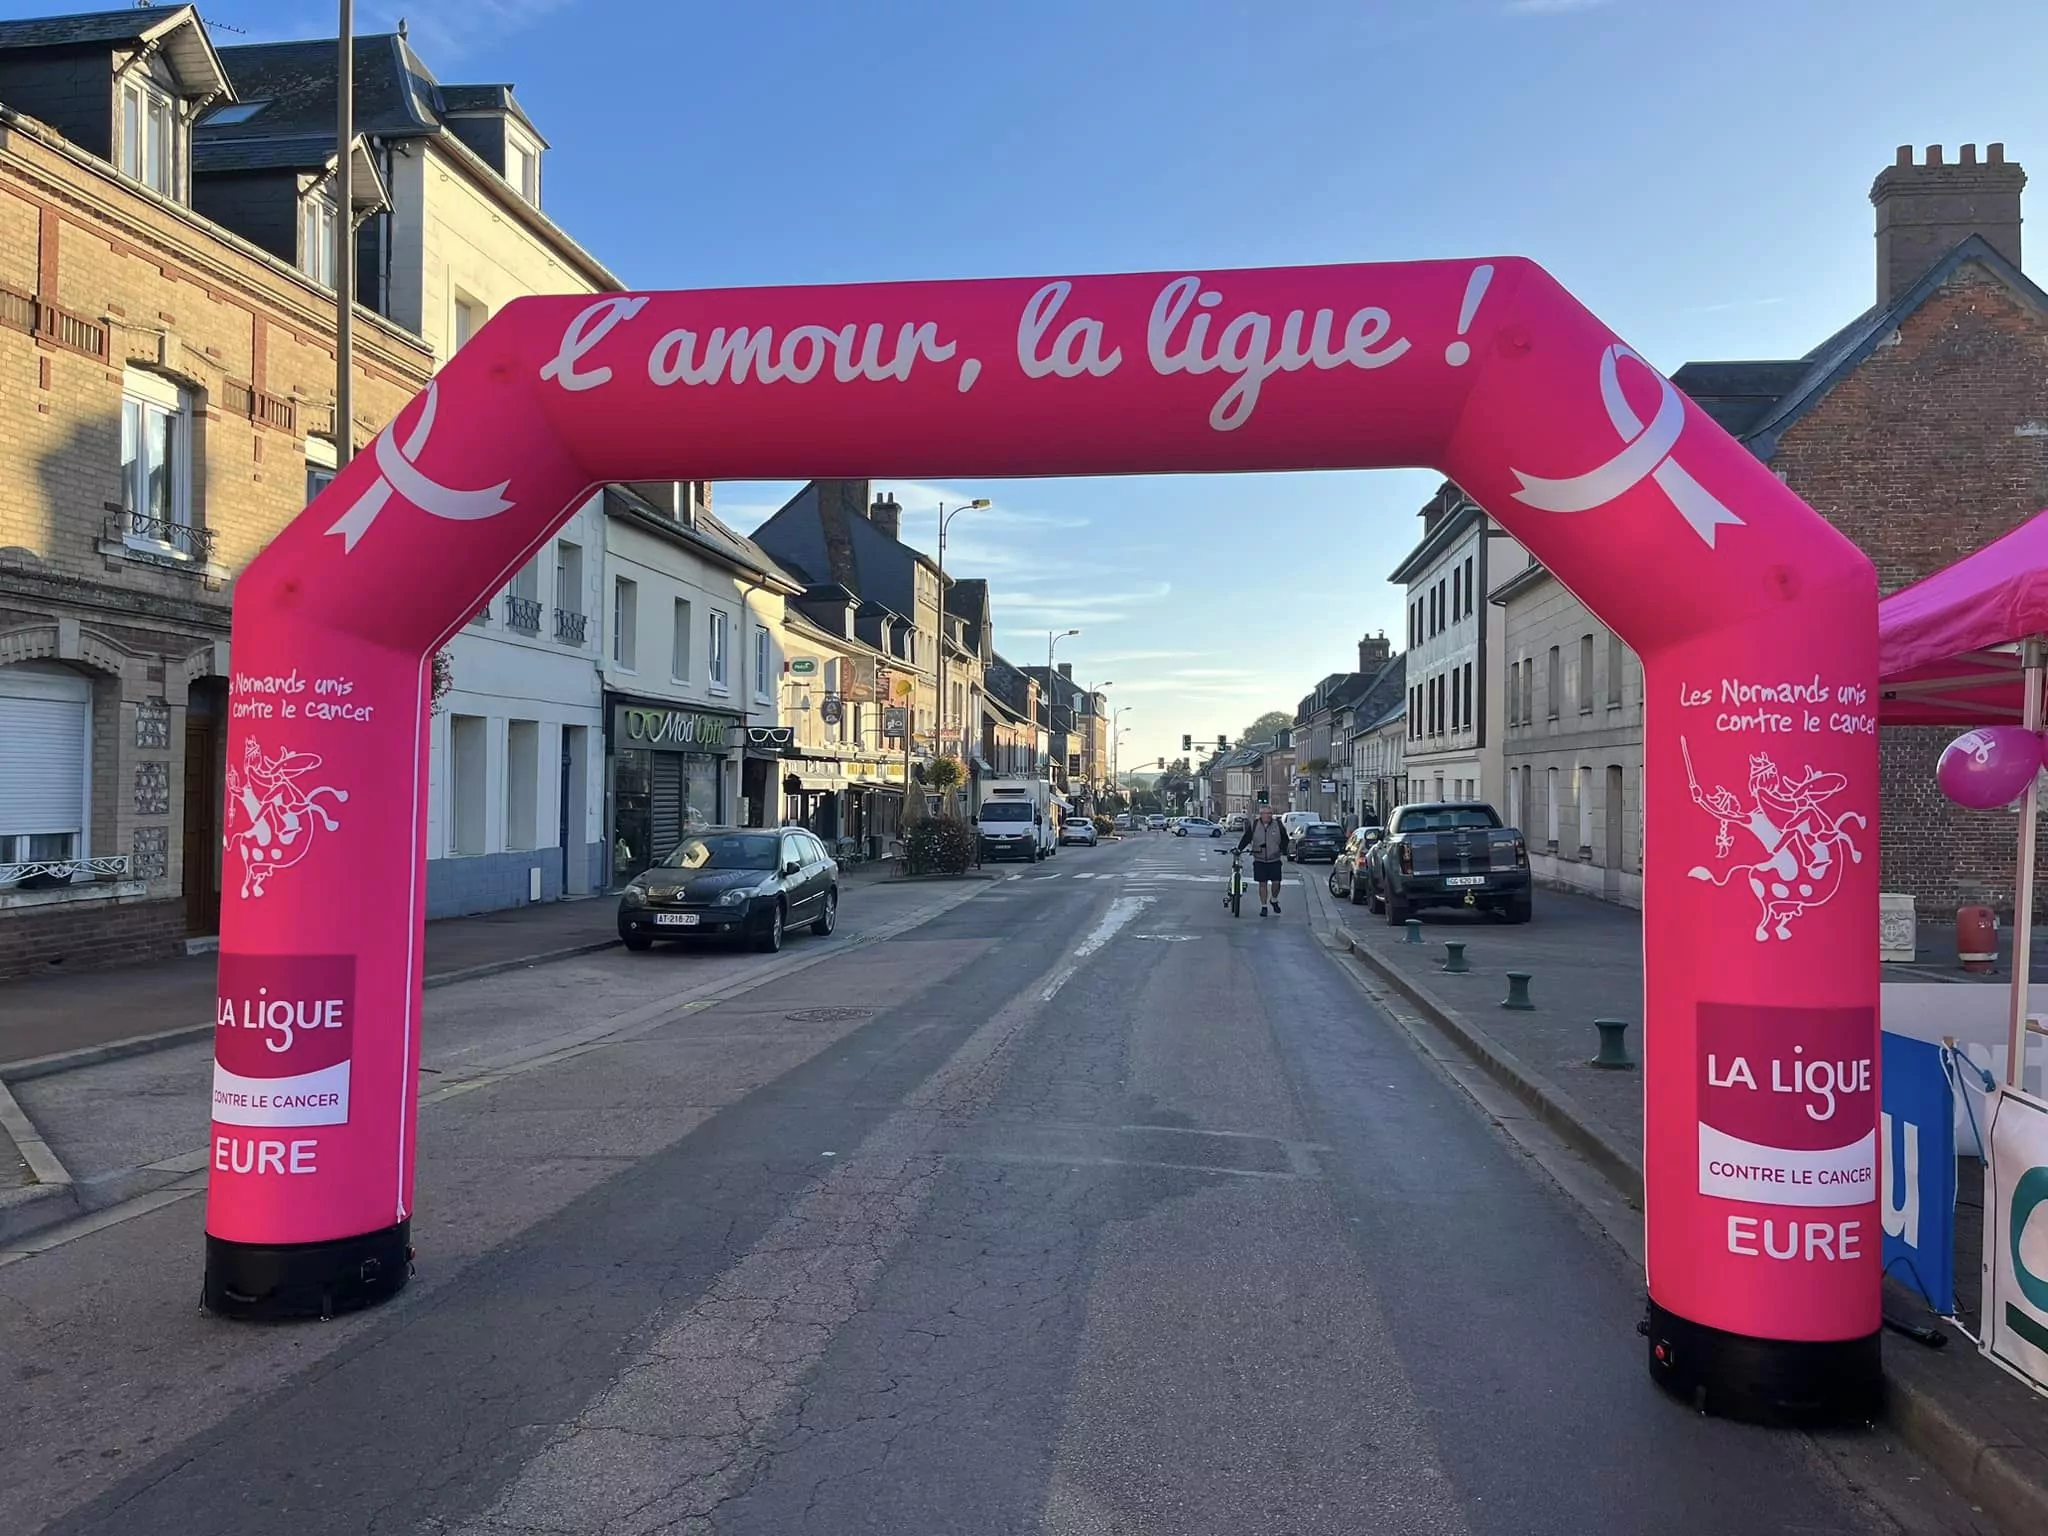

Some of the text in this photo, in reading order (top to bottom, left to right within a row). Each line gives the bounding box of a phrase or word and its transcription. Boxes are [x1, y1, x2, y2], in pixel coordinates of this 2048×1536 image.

[1017, 280, 1122, 379] la
[1147, 276, 1412, 431] ligue
[235, 669, 305, 697] Normands
[315, 677, 353, 696] unis
[1679, 674, 1867, 707] Les Normands unis
[232, 697, 374, 722] contre le cancer
[1716, 708, 1876, 735] contre le cancer
[217, 996, 236, 1028] LA
[1708, 1054, 1758, 1090] LA
[252, 1095, 267, 1108] LE
[272, 1092, 340, 1109] CANCER
[215, 1136, 318, 1175] EURE
[1709, 1161, 1872, 1185] CONTRE LE CANCER
[1727, 1215, 1861, 1261] EURE
